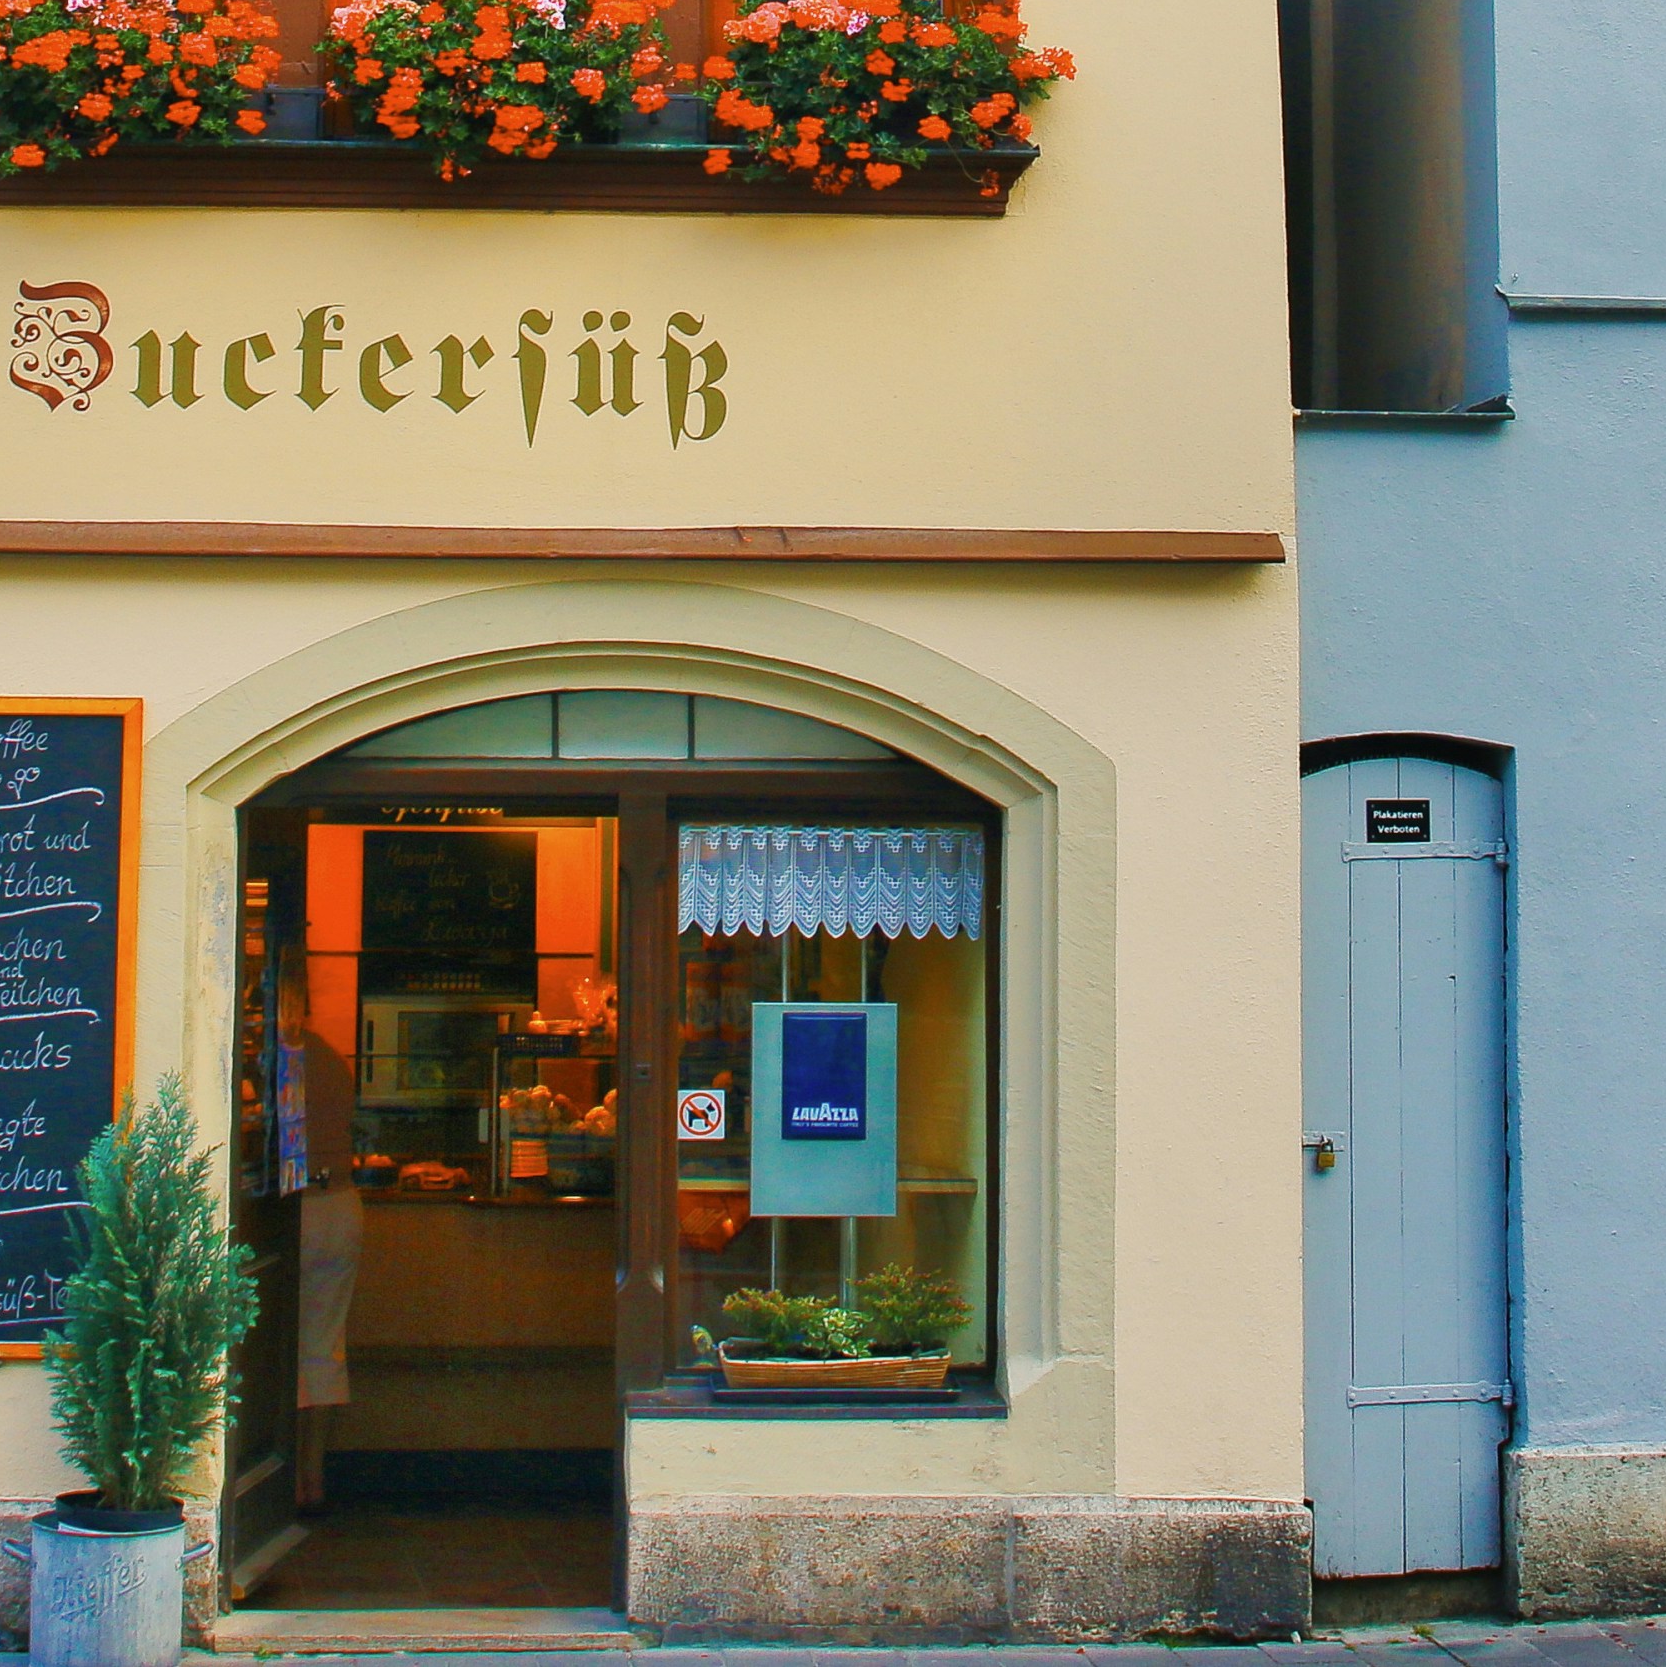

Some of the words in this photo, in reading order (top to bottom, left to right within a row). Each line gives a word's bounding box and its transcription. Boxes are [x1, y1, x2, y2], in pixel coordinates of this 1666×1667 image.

[7, 766, 41, 800] go
[44, 821, 92, 851] und
[792, 1103, 859, 1121] LAVAZZA
